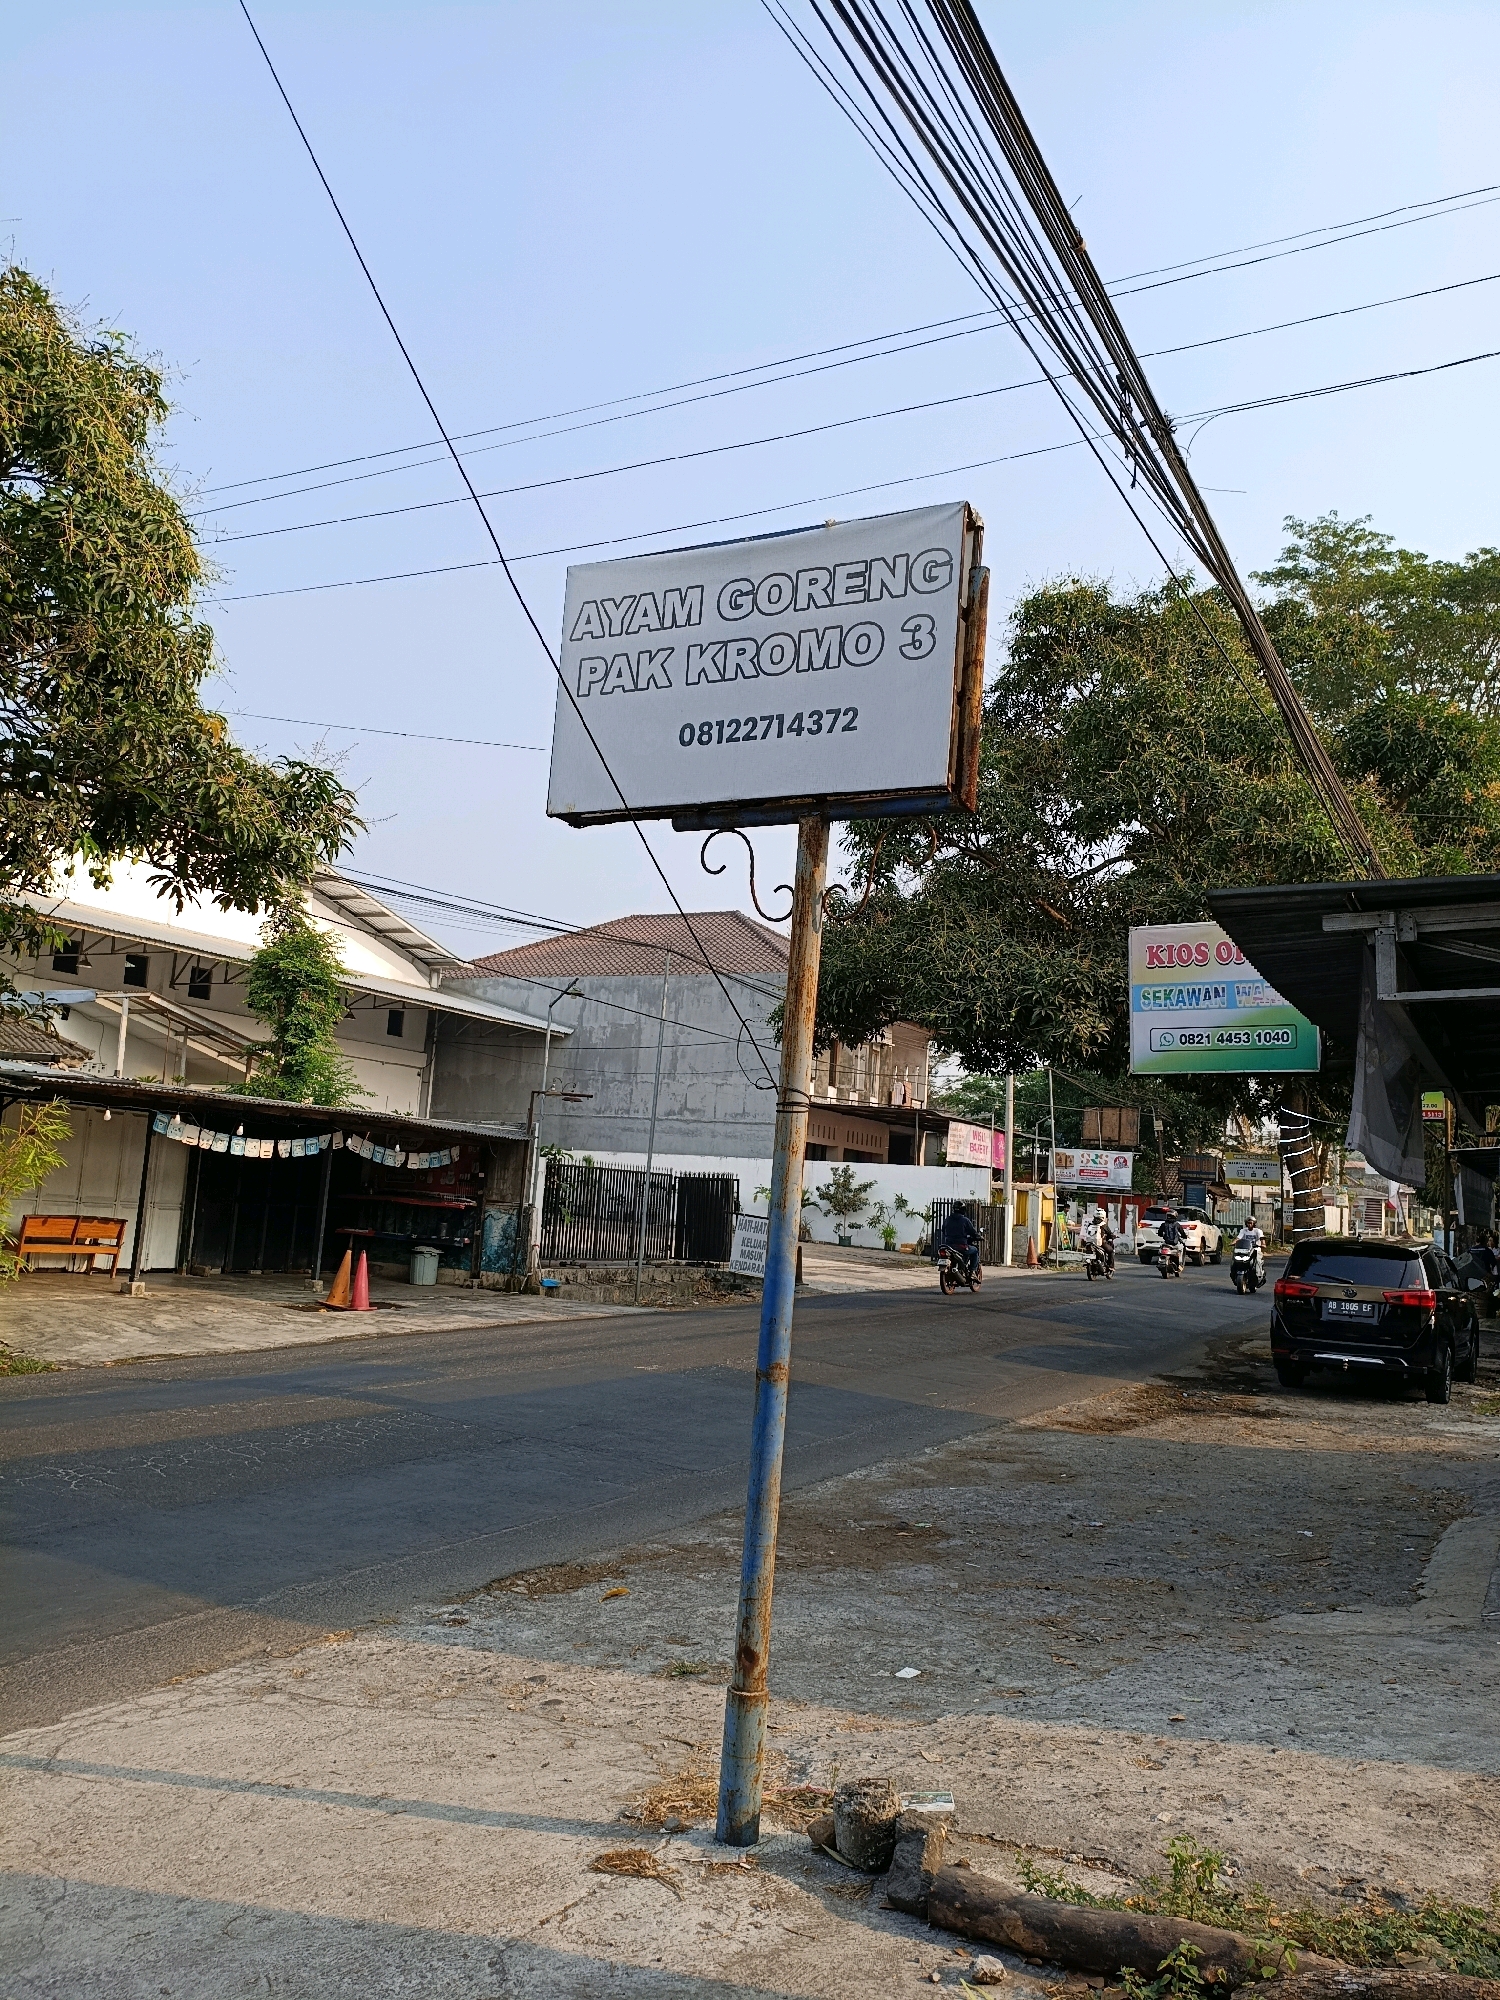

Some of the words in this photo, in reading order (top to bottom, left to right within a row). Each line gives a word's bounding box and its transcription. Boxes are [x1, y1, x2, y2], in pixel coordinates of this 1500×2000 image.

[570, 585, 704, 642] AYAM
[716, 547, 954, 622] GORENG
[577, 647, 674, 697] PAK
[686, 621, 885, 686] KROMO
[899, 613, 936, 661] 3
[678, 706, 859, 747] 08122714372
[1146, 941, 1209, 968] KIOS
[1141, 984, 1227, 1010] SEKAWAN
[1179, 1032, 1211, 1046] 0821
[1216, 1031, 1251, 1045] 4453
[1255, 1029, 1290, 1045] 1040
[741, 1236, 767, 1251] KELUAR
[739, 1248, 764, 1262] MASUK
[730, 1259, 765, 1275] KENDARAA
[1328, 1300, 1337, 1309] AB
[1340, 1302, 1359, 1311] 1805
[1362, 1303, 1373, 1312] EF
